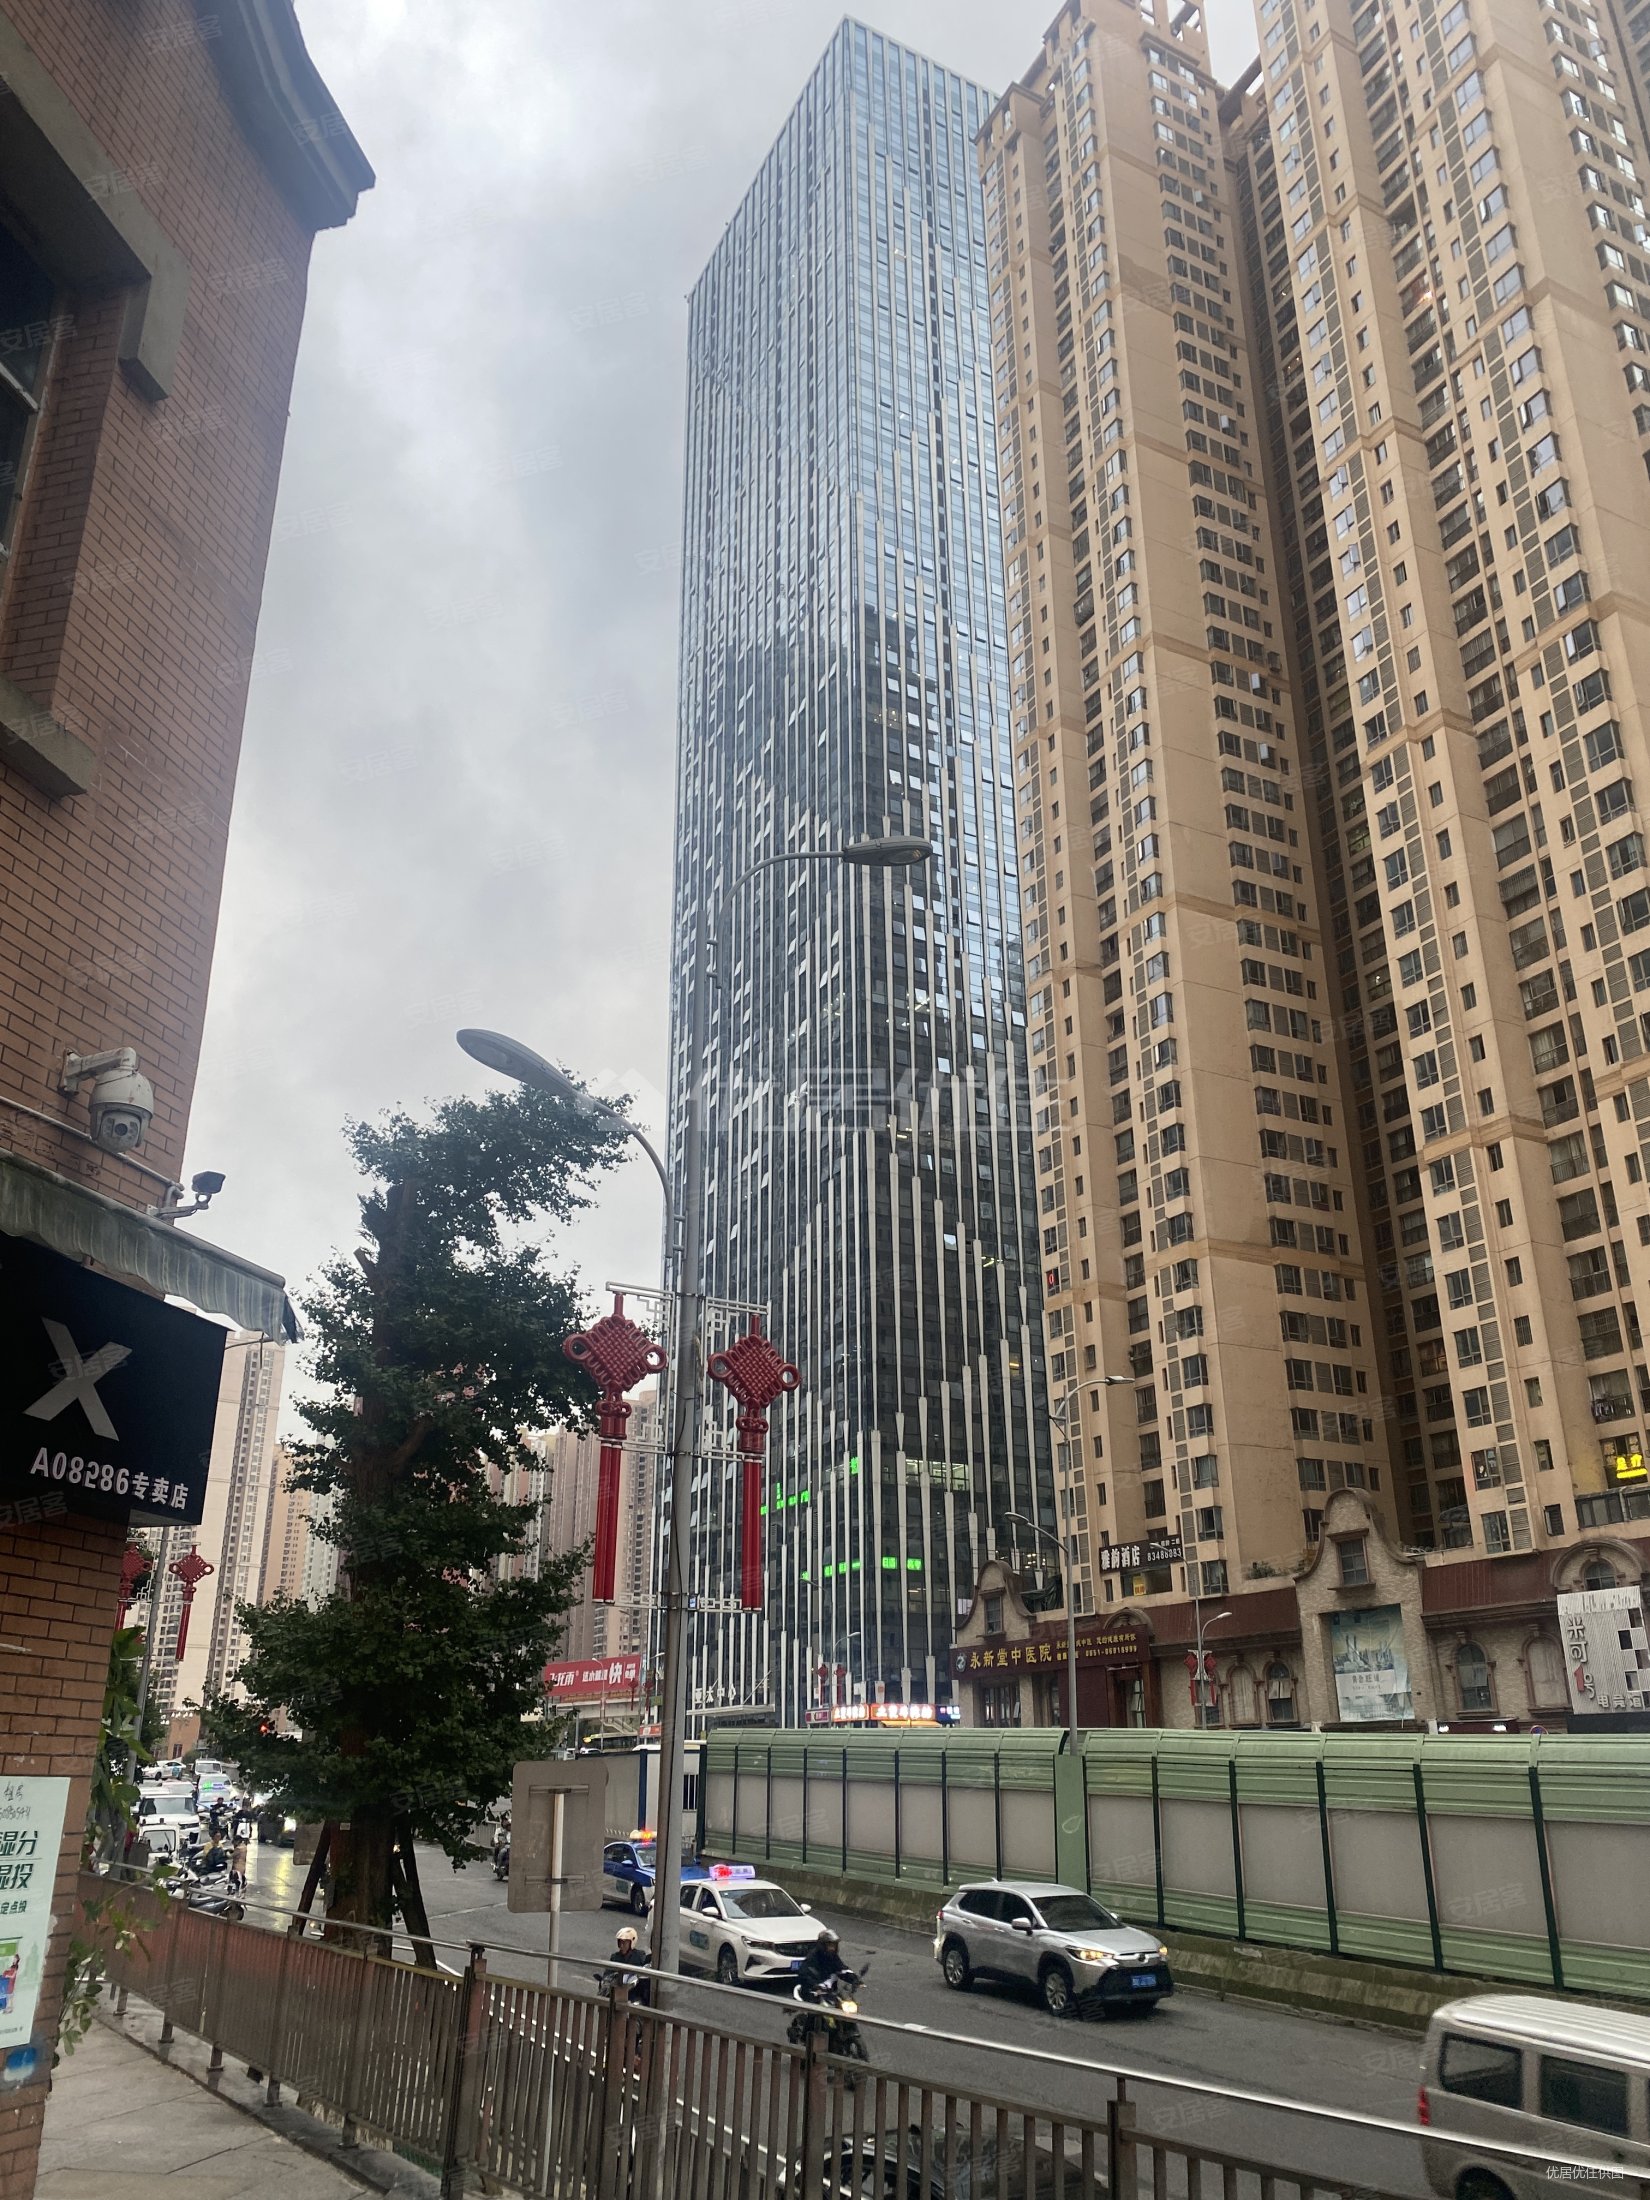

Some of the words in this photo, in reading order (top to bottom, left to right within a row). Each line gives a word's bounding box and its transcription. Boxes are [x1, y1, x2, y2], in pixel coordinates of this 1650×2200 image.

[30, 1447, 189, 1510] A08286专卖店
[970, 1643, 1052, 1670] 永新堂中医院
